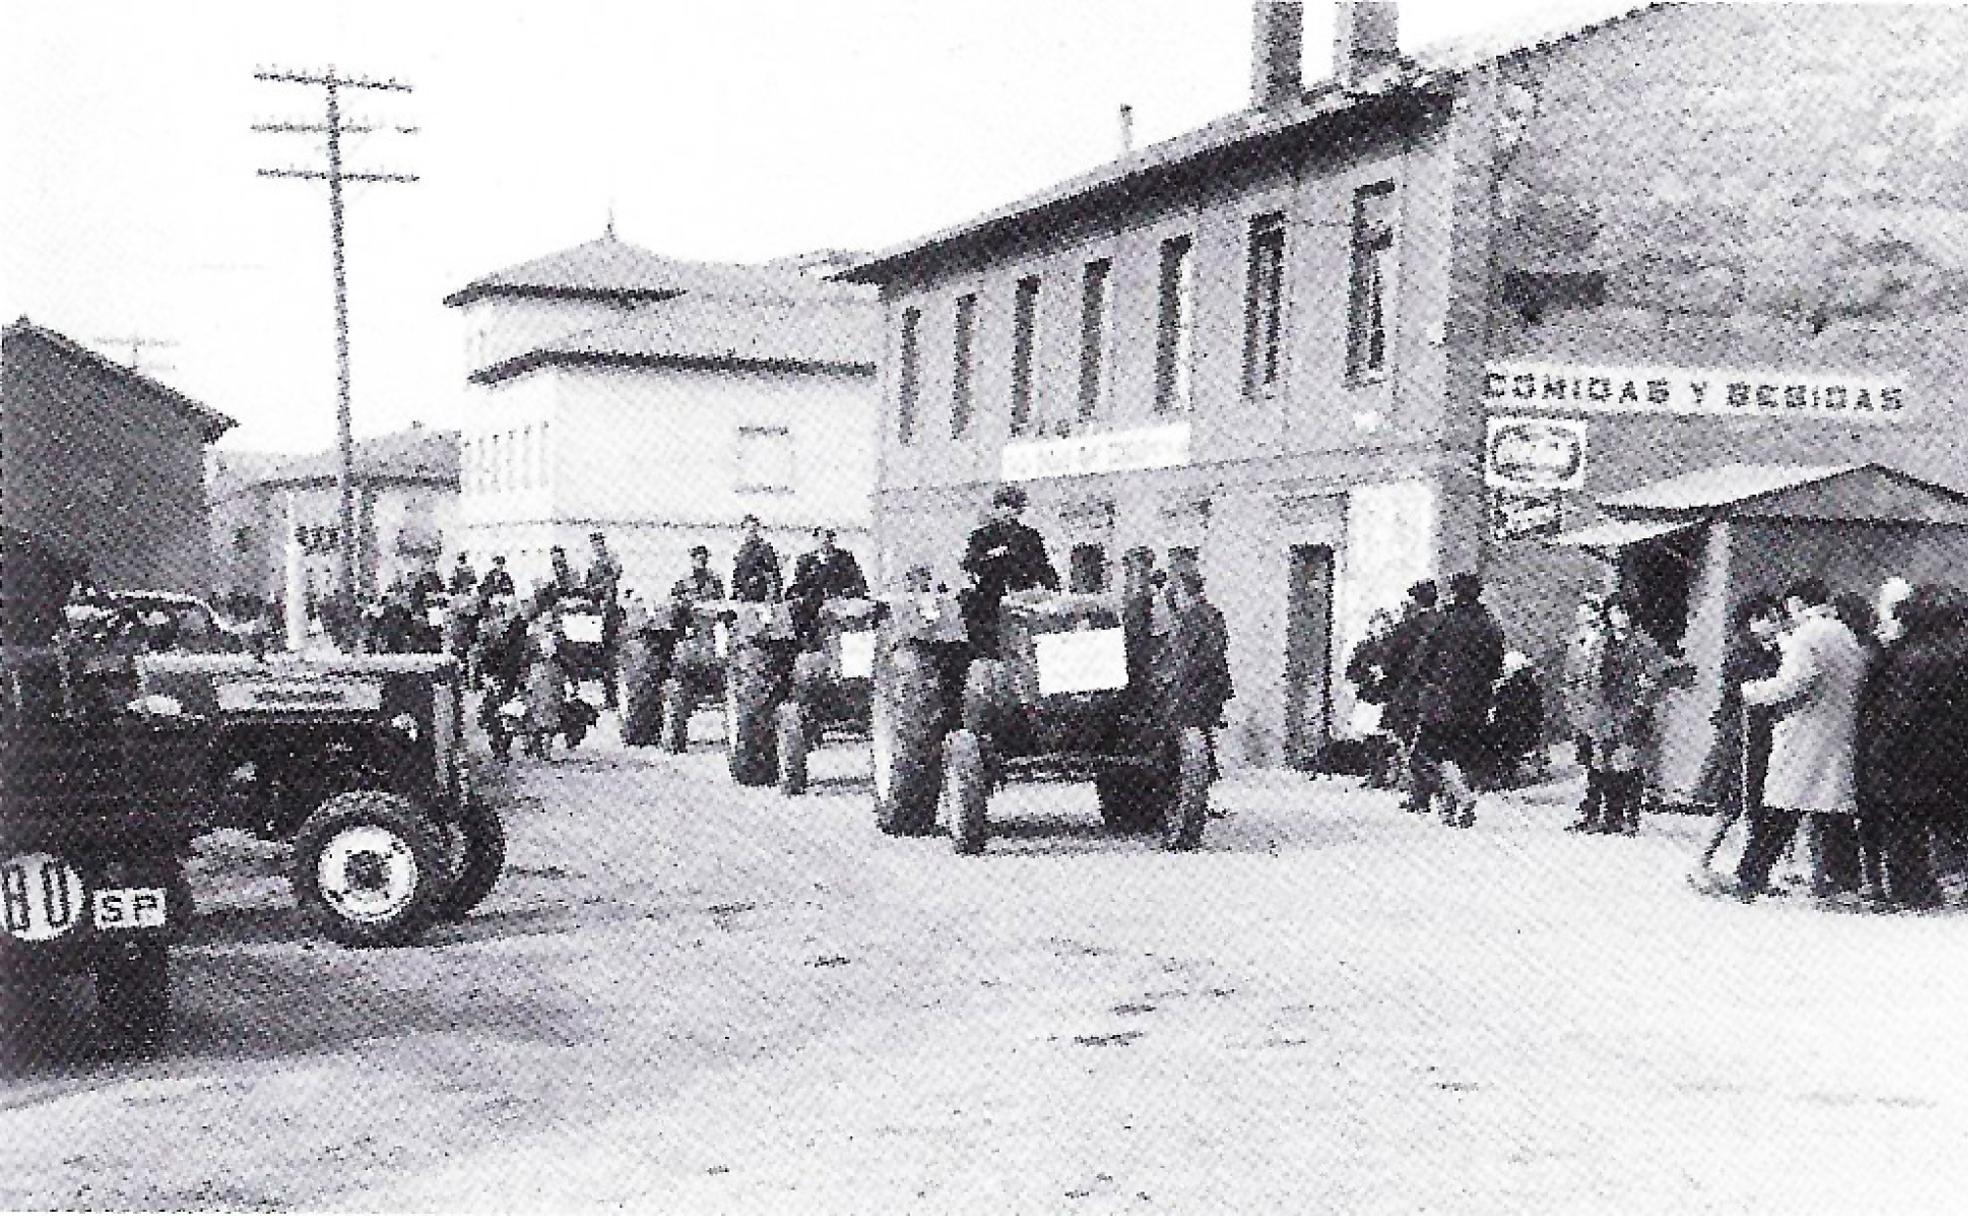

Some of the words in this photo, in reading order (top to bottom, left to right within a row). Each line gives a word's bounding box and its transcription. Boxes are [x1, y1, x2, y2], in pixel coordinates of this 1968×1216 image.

[1482, 371, 1670, 404] COMIDAS
[1690, 380, 1708, 405] Y
[1726, 381, 1903, 412] BEBIDAS
[101, 892, 158, 923] SP
